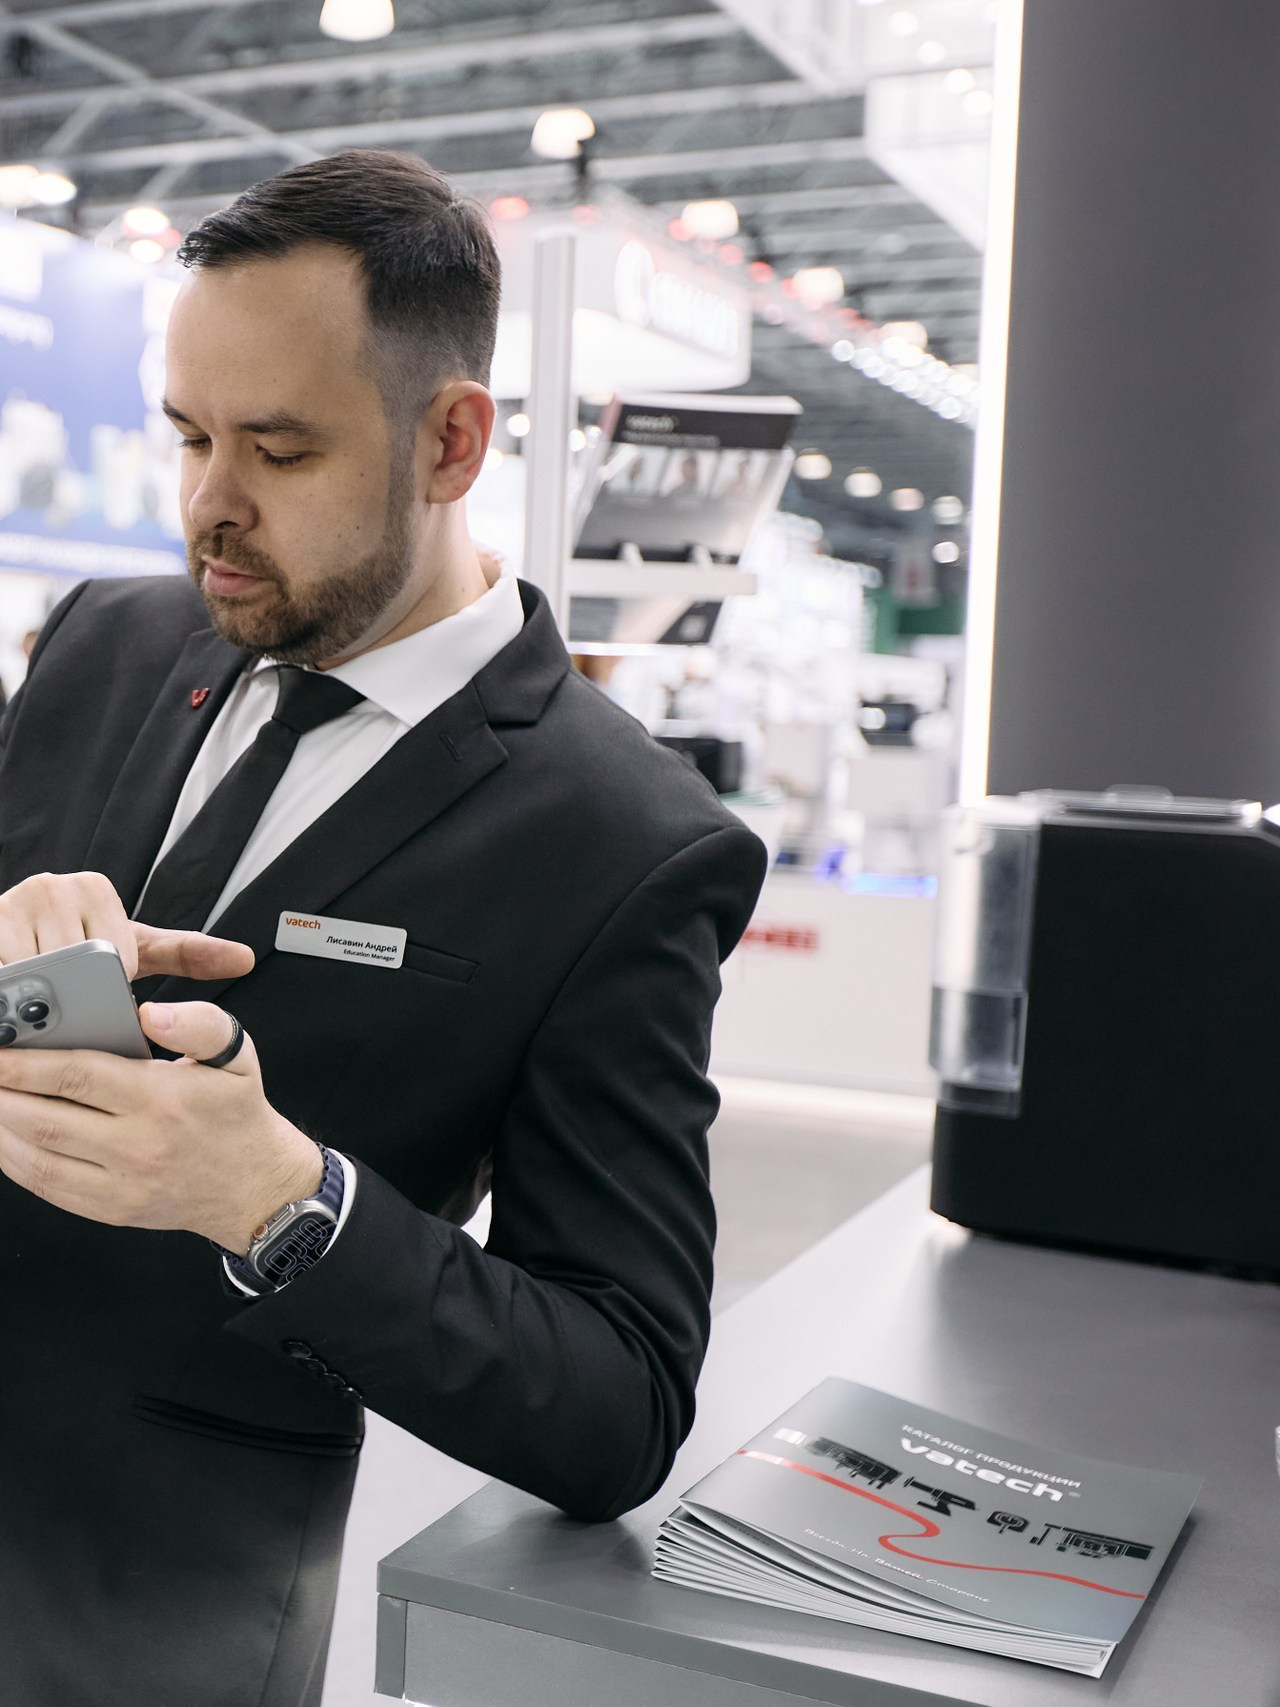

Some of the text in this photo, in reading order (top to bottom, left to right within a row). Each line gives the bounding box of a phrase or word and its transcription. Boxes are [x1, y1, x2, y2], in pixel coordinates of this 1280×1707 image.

[285, 917, 321, 930] vatech
[326, 935, 397, 953] Лисавин Андрей
[343, 949, 395, 962] Education Manager
[901, 1424, 1081, 1488] КАТАЛОГ ПРОДУКЦИИ
[901, 1437, 1064, 1502] vatech
